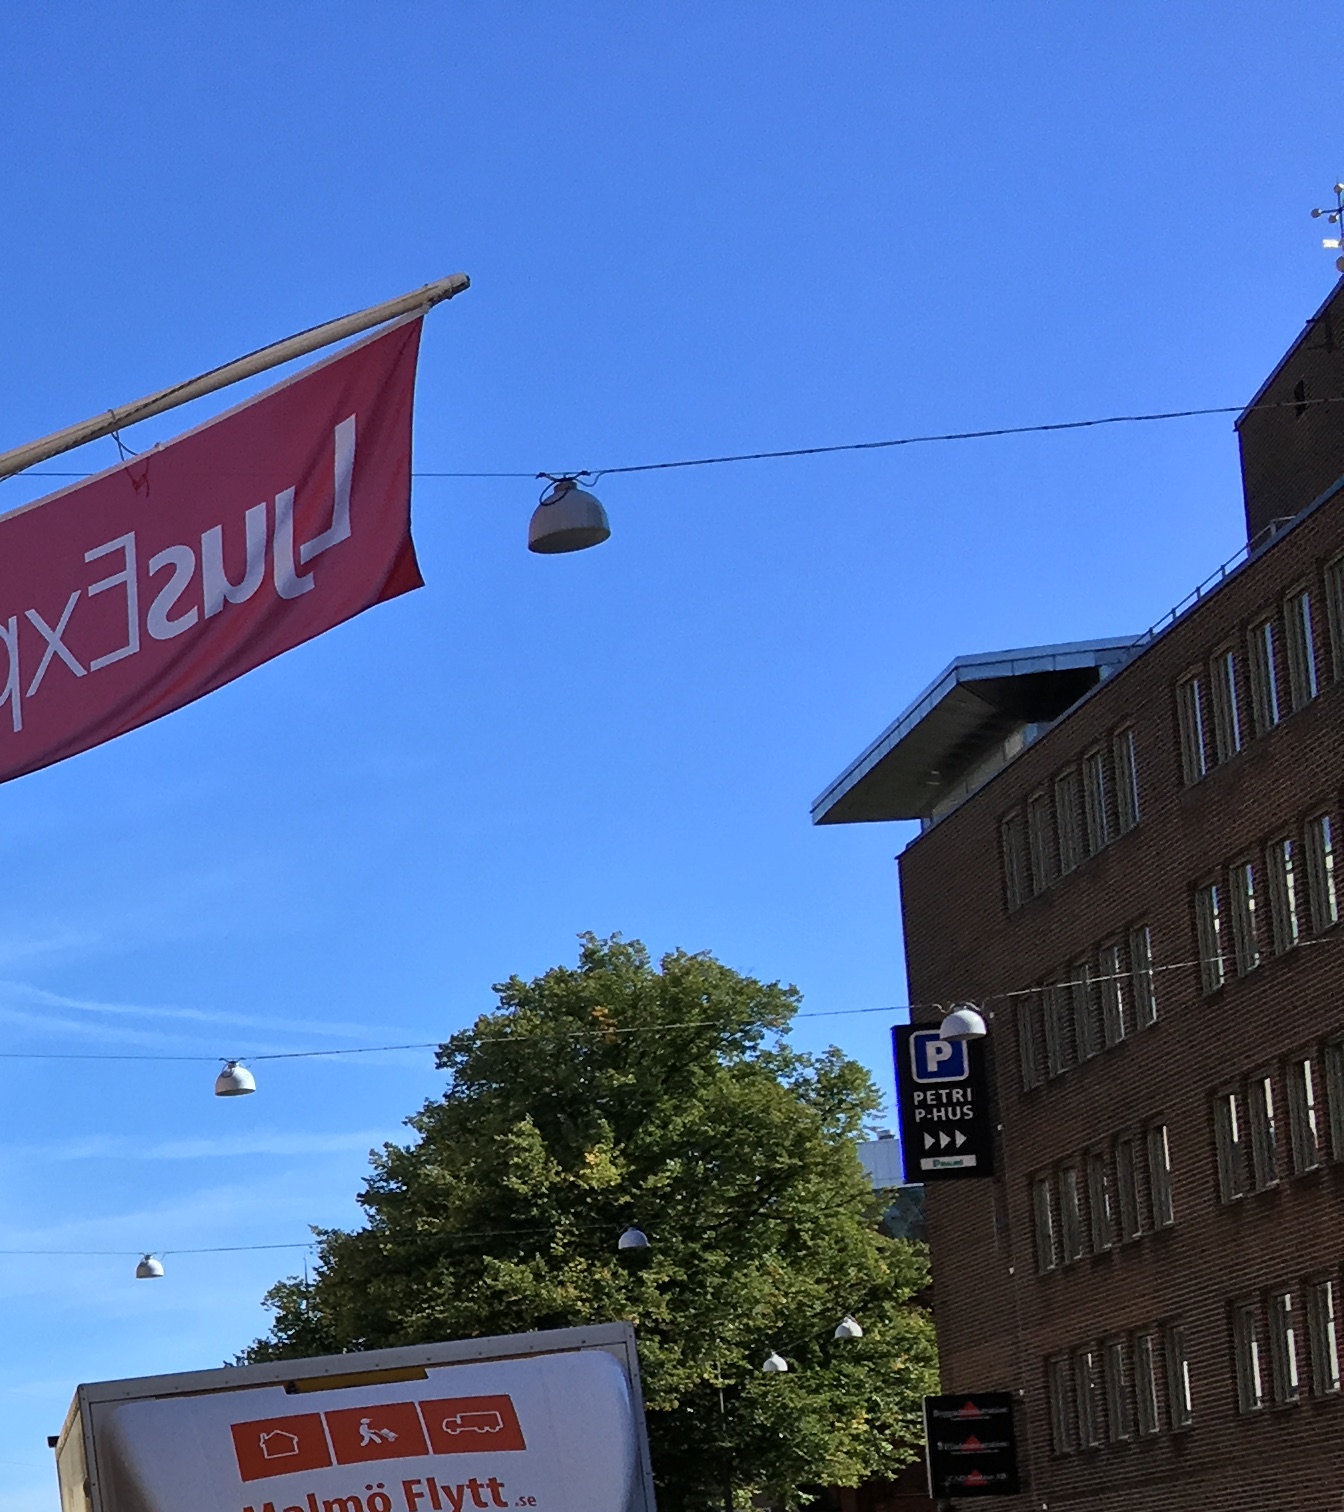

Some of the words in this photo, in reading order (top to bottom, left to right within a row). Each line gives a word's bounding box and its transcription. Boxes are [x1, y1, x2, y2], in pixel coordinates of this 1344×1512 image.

[925, 1041, 953, 1072] P
[914, 1087, 973, 1106] PETRI
[915, 1105, 974, 1122] P-HUS
[515, 1492, 537, 1509] .se
